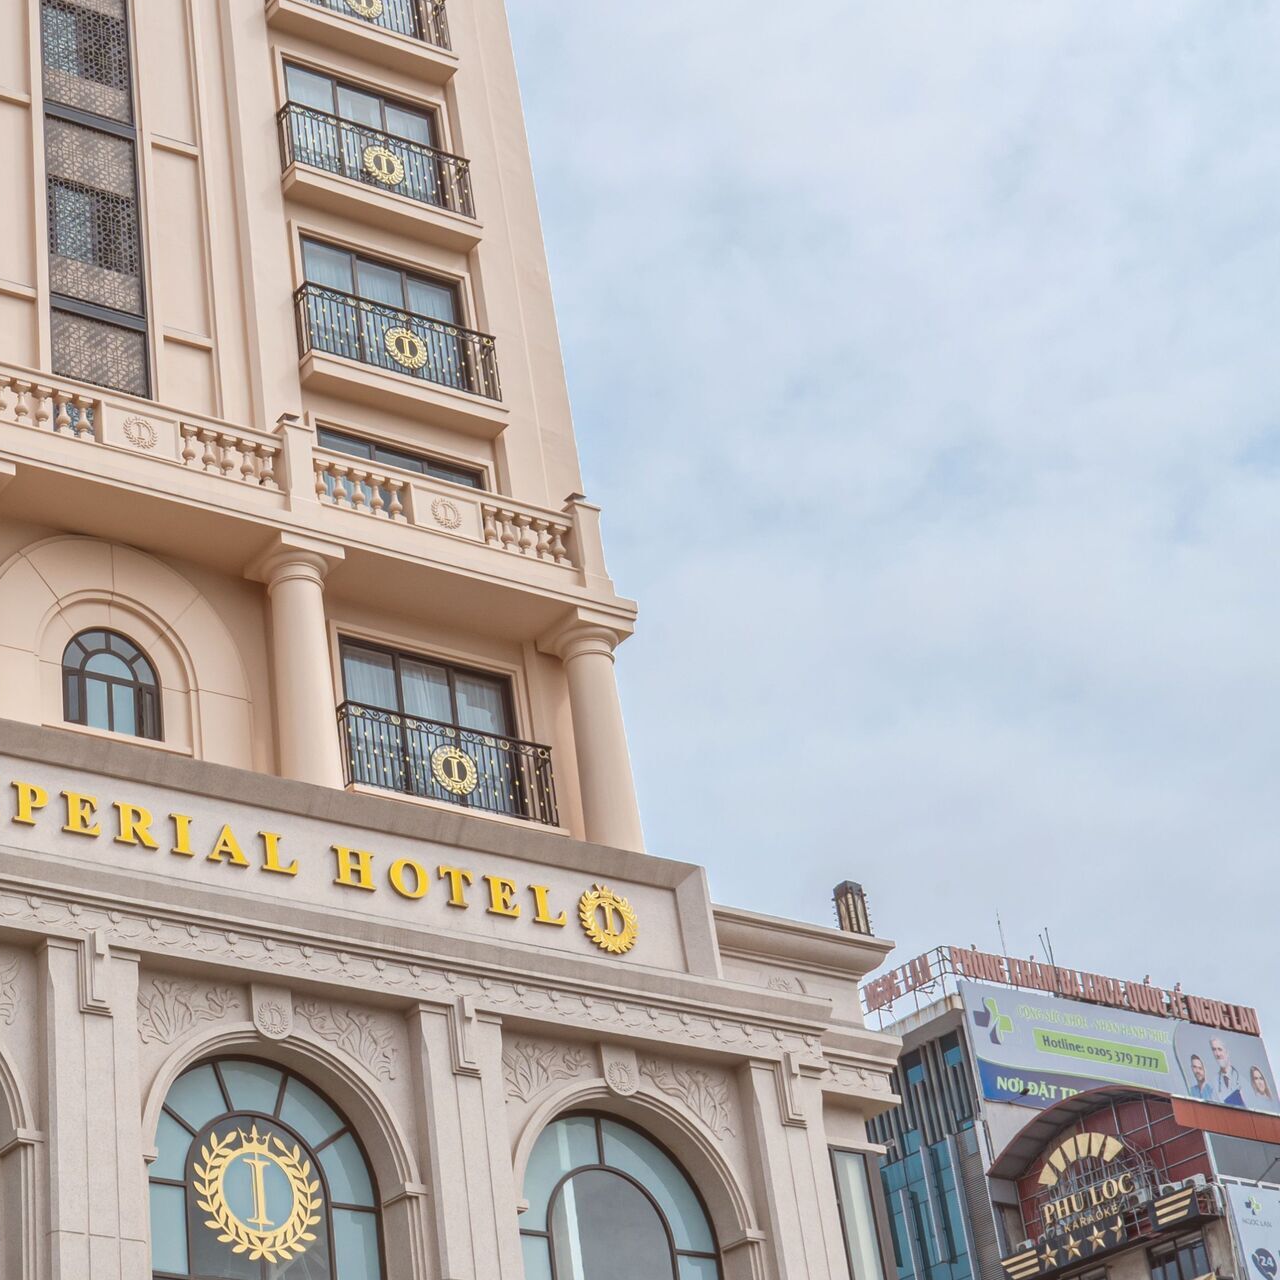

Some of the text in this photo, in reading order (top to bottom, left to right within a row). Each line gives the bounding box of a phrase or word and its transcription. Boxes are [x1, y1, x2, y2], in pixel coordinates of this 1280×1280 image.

[331, 844, 567, 927] HOTEL
[1082, 972, 1125, 1006] KHOA
[1230, 1004, 1262, 1037] LAN
[1042, 1035, 1159, 1069] Hotline: 0205 379 7777
[1027, 1078, 1057, 1101] ĐẶT
[1259, 1255, 1275, 1268] 24
